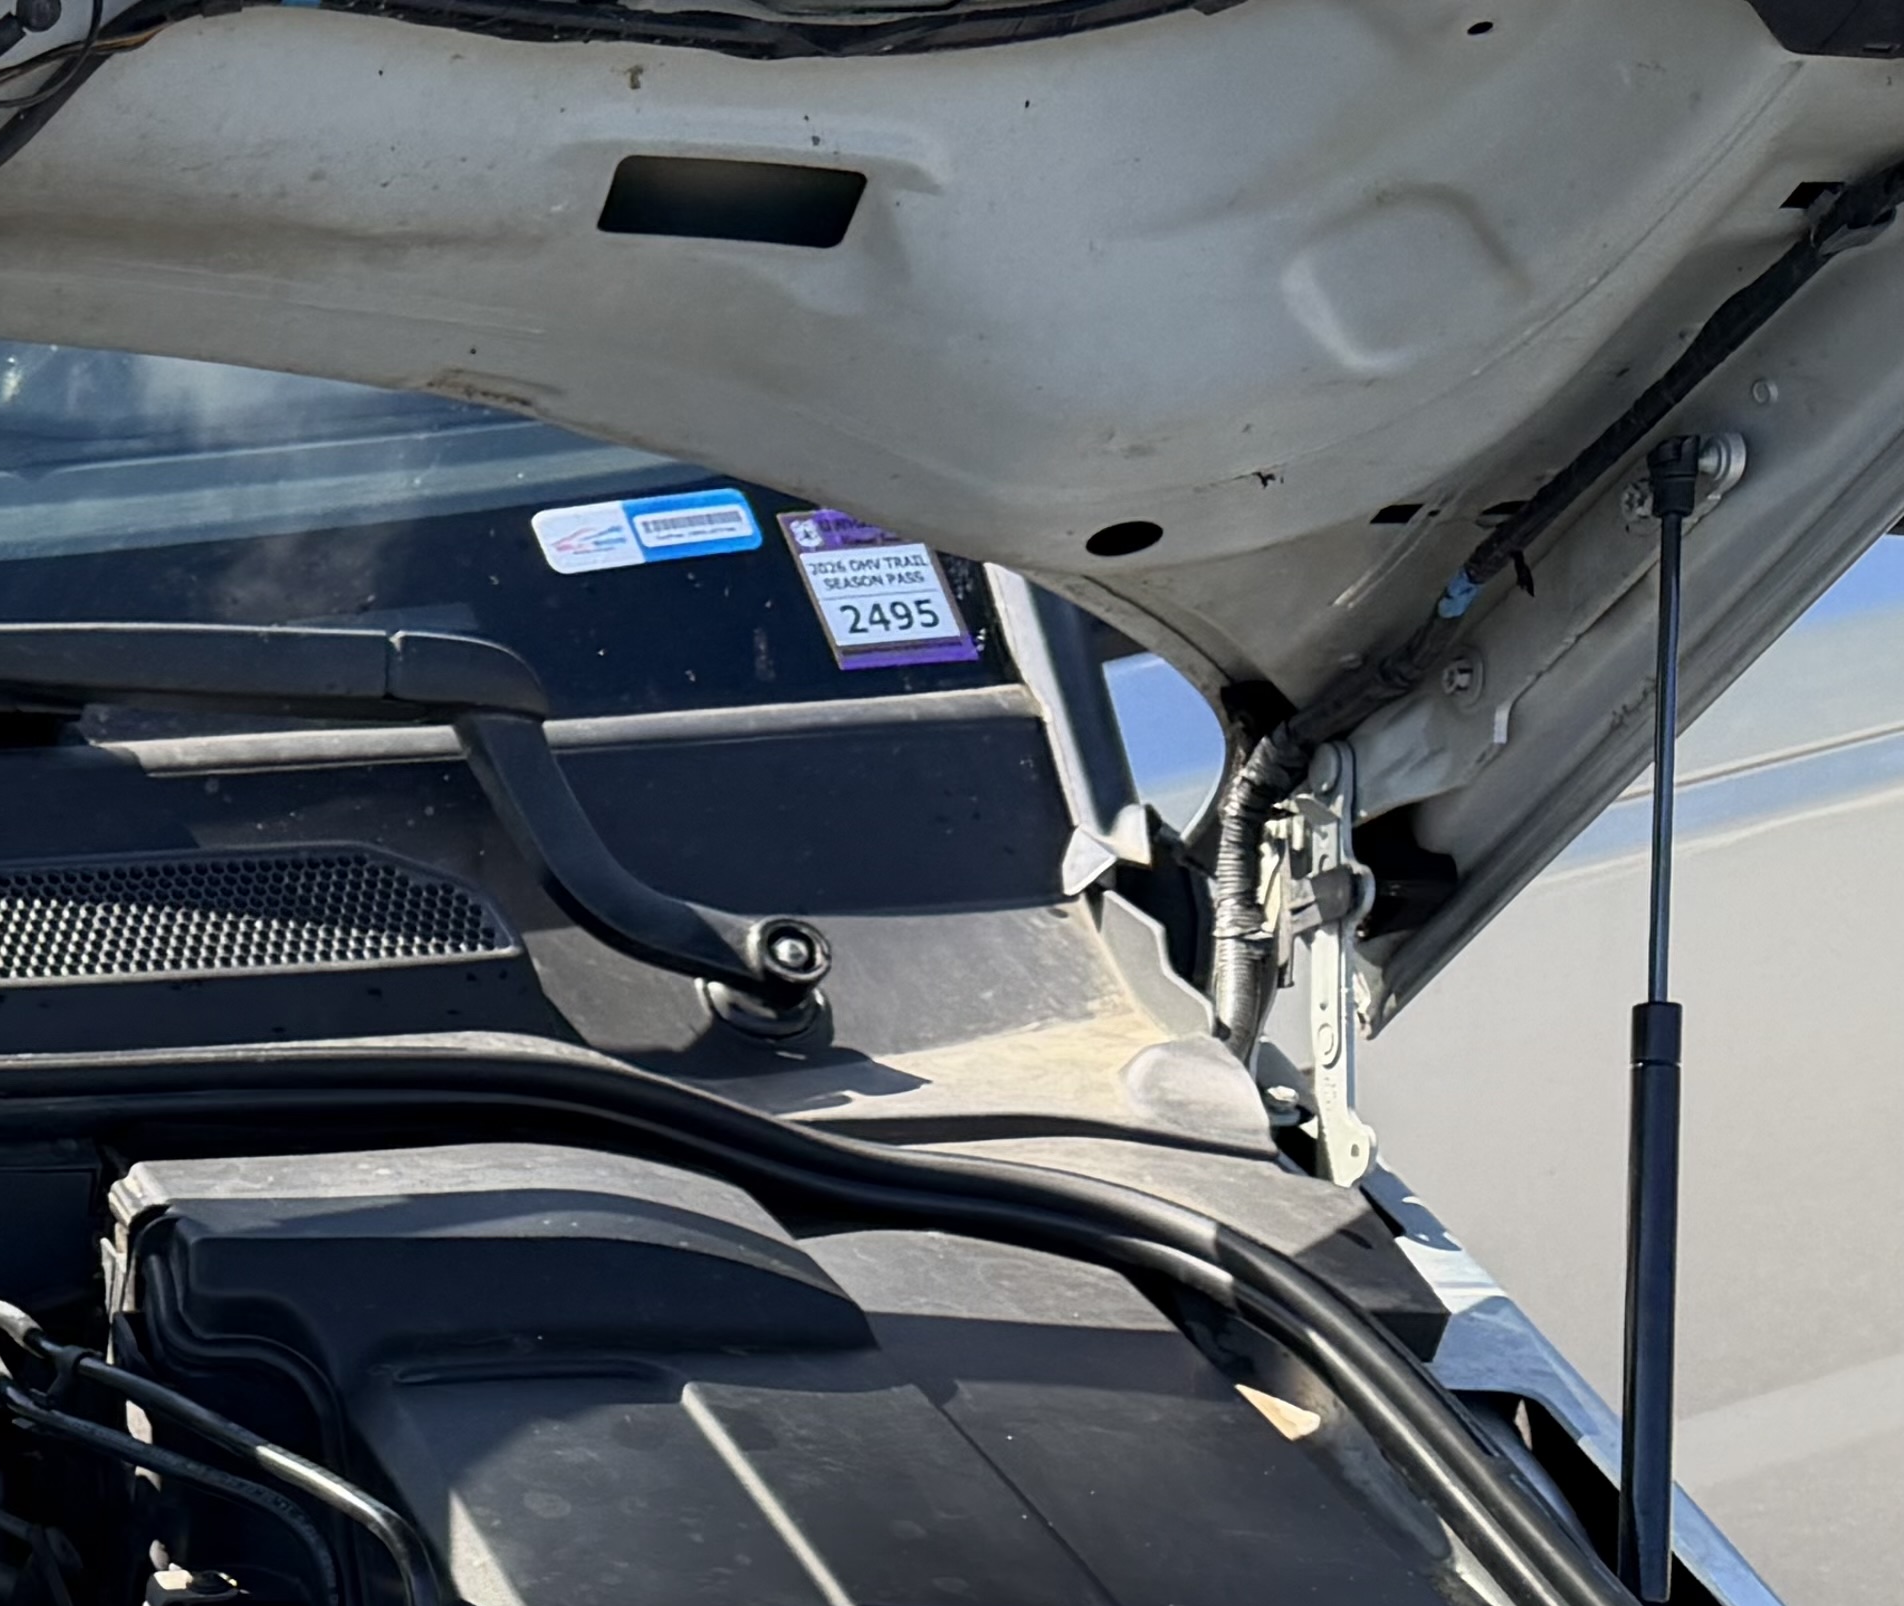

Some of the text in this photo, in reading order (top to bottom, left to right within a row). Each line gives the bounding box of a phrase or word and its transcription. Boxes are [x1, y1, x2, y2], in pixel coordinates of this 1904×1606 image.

[882, 554, 929, 570] TRAIL
[823, 570, 926, 591] SEASON PASS
[839, 598, 941, 635] 2495
